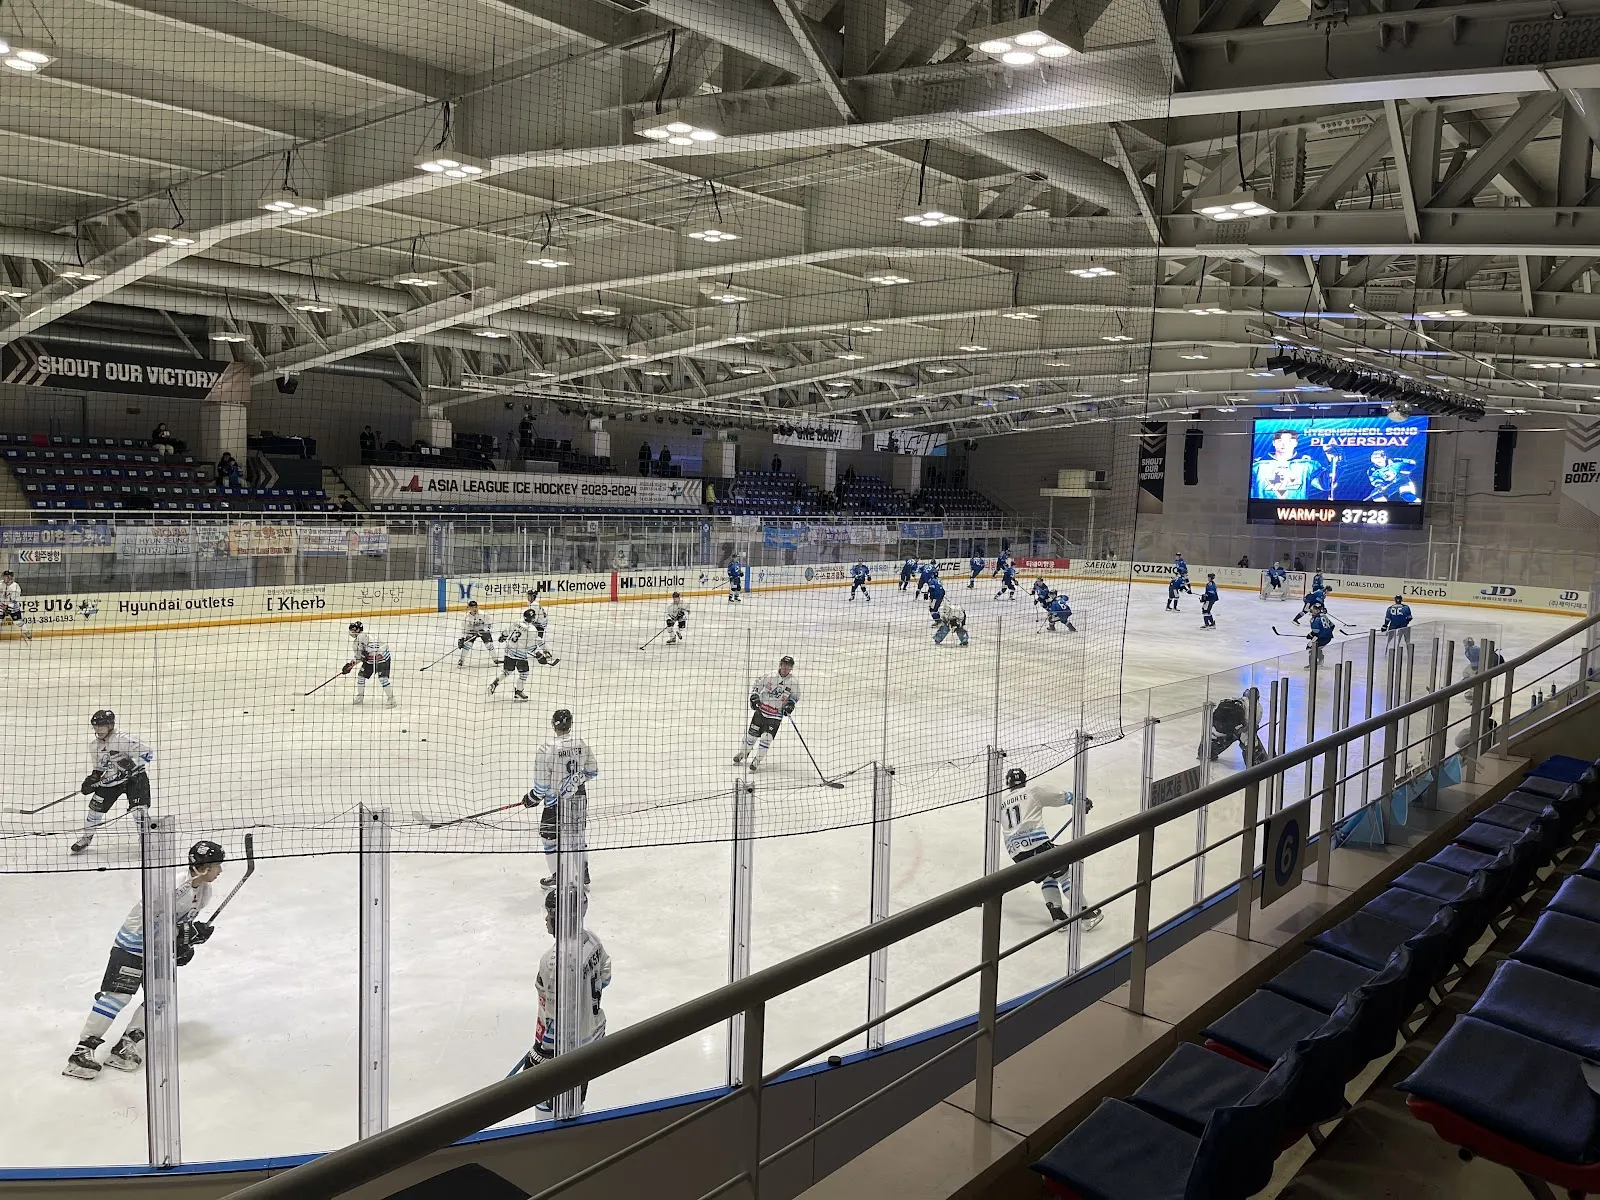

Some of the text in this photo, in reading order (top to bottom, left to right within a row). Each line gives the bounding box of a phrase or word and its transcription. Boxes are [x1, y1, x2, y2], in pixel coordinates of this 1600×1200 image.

[37, 355, 224, 389] SHOUT OUR VICTORY!
[1310, 437, 1409, 447] PLAYERSDAY
[1141, 457, 1163, 466] SHOUT
[1572, 461, 1597, 472] ONE
[1145, 465, 1158, 473] OUR
[427, 478, 459, 492] ASIA
[463, 479, 509, 494] LEAGUE
[513, 481, 531, 495] ICE
[534, 482, 579, 496] HOCKEY
[581, 483, 637, 497] 2023-2024
[1276, 507, 1389, 524] WARM-UP 37:28
[1085, 561, 1117, 569] SAERON
[537, 579, 606, 593] HL Klemove
[620, 575, 685, 589] HL D&I Halla
[1480, 586, 1517, 597] JD
[1559, 591, 1579, 601] JD
[44, 599, 73, 612] U16
[119, 596, 234, 615] Hyundai outlets
[1006, 805, 1021, 829] 11
[1281, 834, 1294, 873] 6
